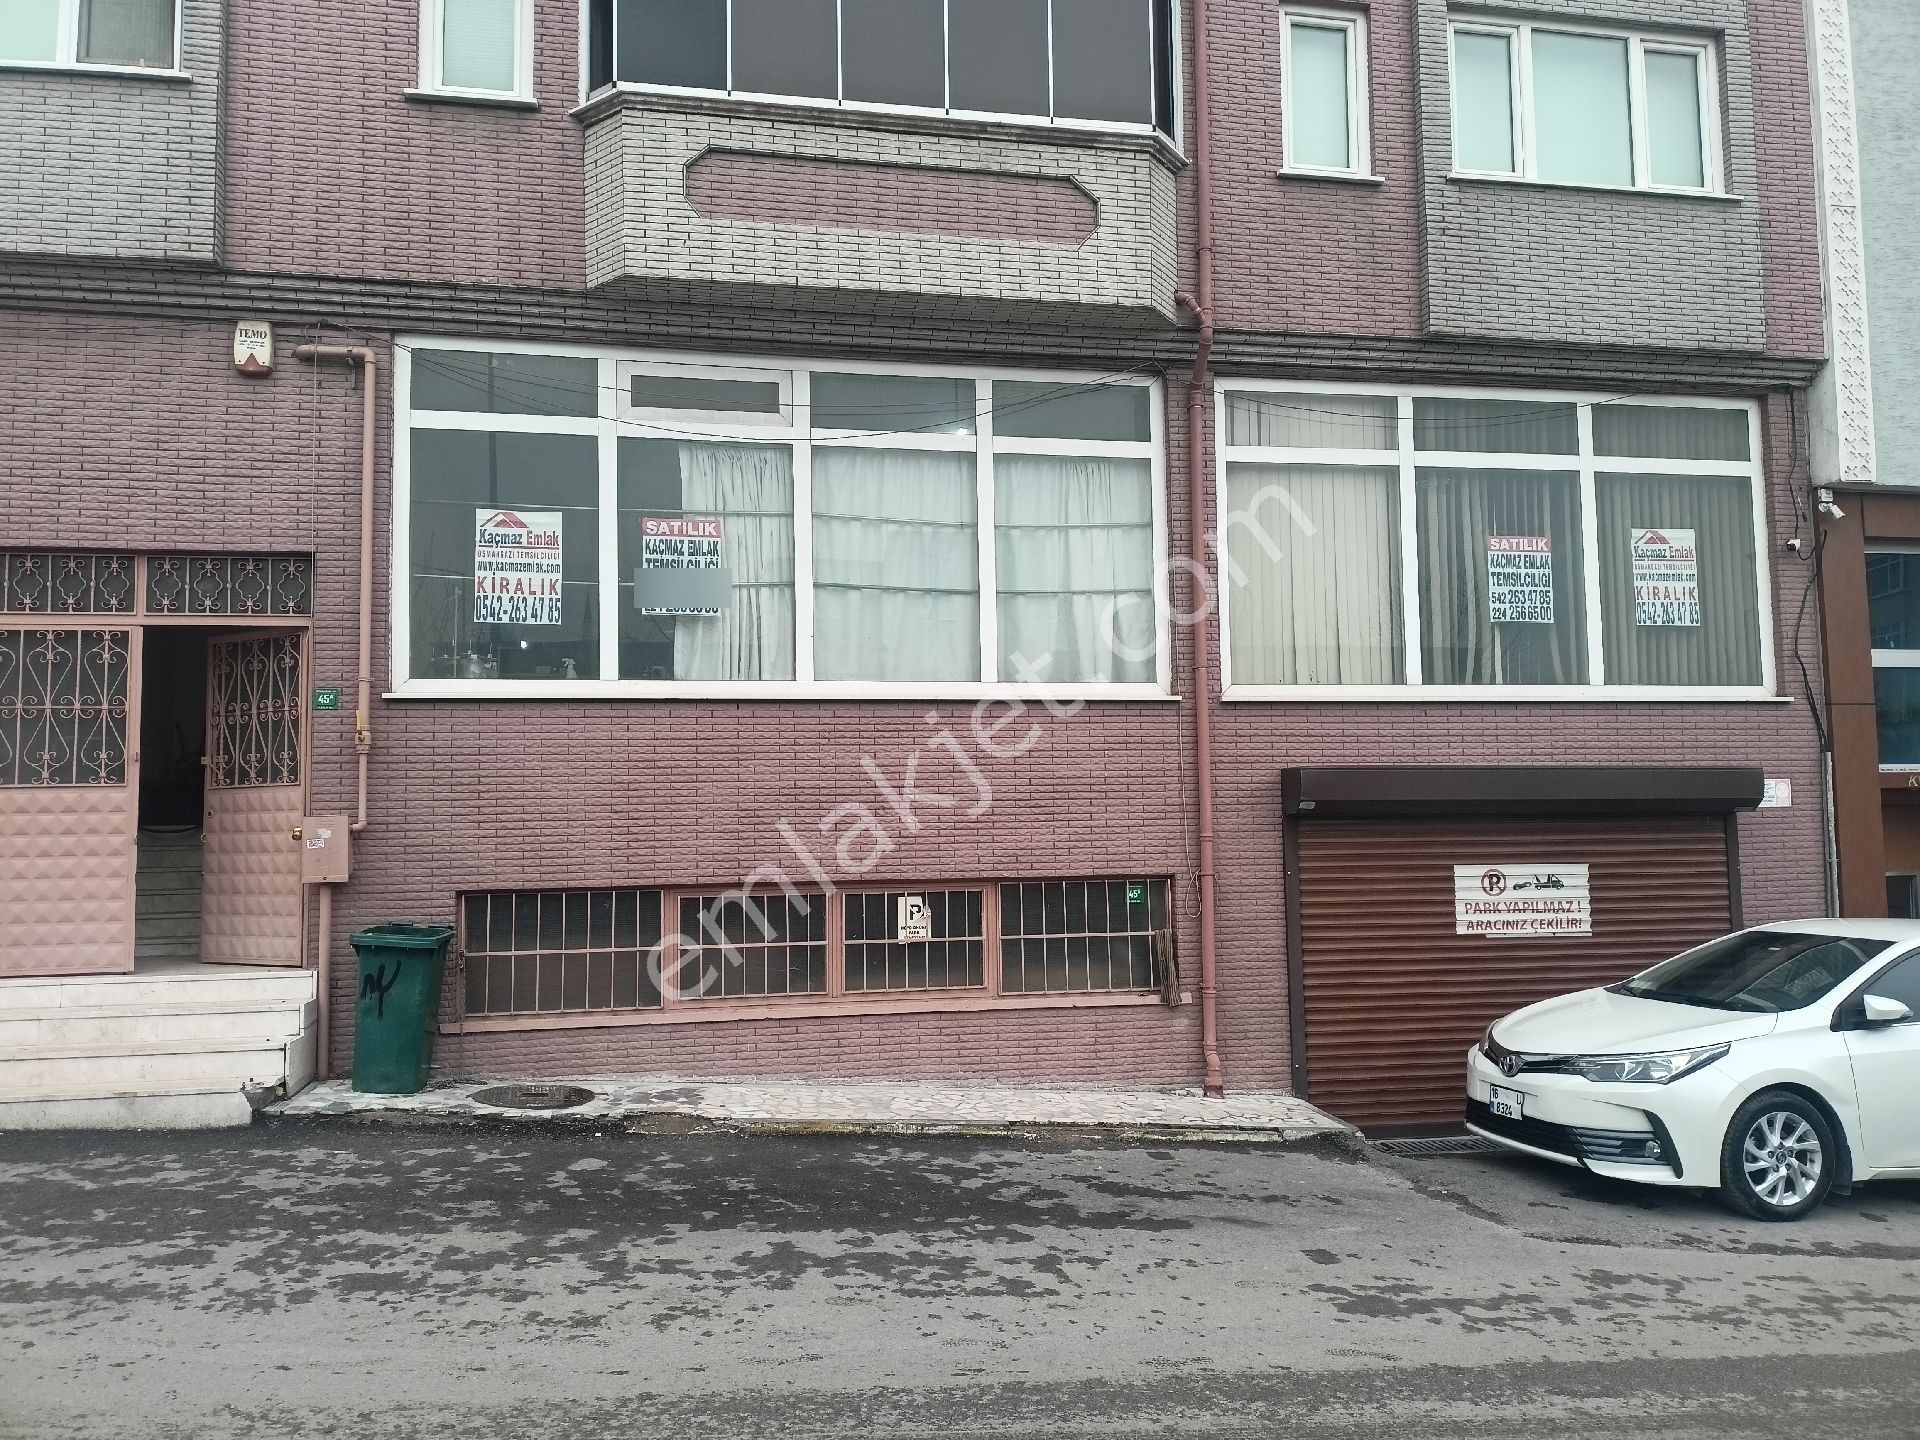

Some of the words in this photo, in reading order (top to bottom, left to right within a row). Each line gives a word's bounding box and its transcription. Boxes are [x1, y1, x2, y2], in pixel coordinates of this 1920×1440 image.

[238, 328, 267, 339] TEMO
[645, 521, 718, 536] SATILIK
[479, 529, 522, 548] Kaçmaz
[526, 530, 560, 546] Emlak
[1490, 539, 1548, 551] SATILIK
[688, 540, 719, 557] EMLAK
[1634, 546, 1667, 561] Kaçmaz
[1669, 546, 1694, 558] Emlak
[478, 560, 560, 573] www.kacmazemlak.com
[1524, 554, 1550, 569] EMLAK
[477, 572, 559, 595] KİRALIK
[1492, 592, 1506, 604] 542
[1636, 582, 1696, 601] KİRALIK
[476, 595, 528, 622] 0542-263
[531, 597, 544, 622] 47
[548, 598, 560, 623] 85
[1492, 607, 1506, 620] 224
[1637, 602, 1675, 624] 0542-263
[1678, 602, 1686, 624] 47
[1689, 602, 1699, 624] 85
[1909, 775, 1920, 786] K
[1465, 902, 1501, 914] PARK
[1504, 901, 1575, 914] YAPILMAZ
[1467, 920, 1527, 931] ARACINIZ
[1531, 916, 1582, 933] ÇEKİLİR!
[1492, 1087, 1498, 1099] 16
[1497, 1102, 1512, 1116] 8324
